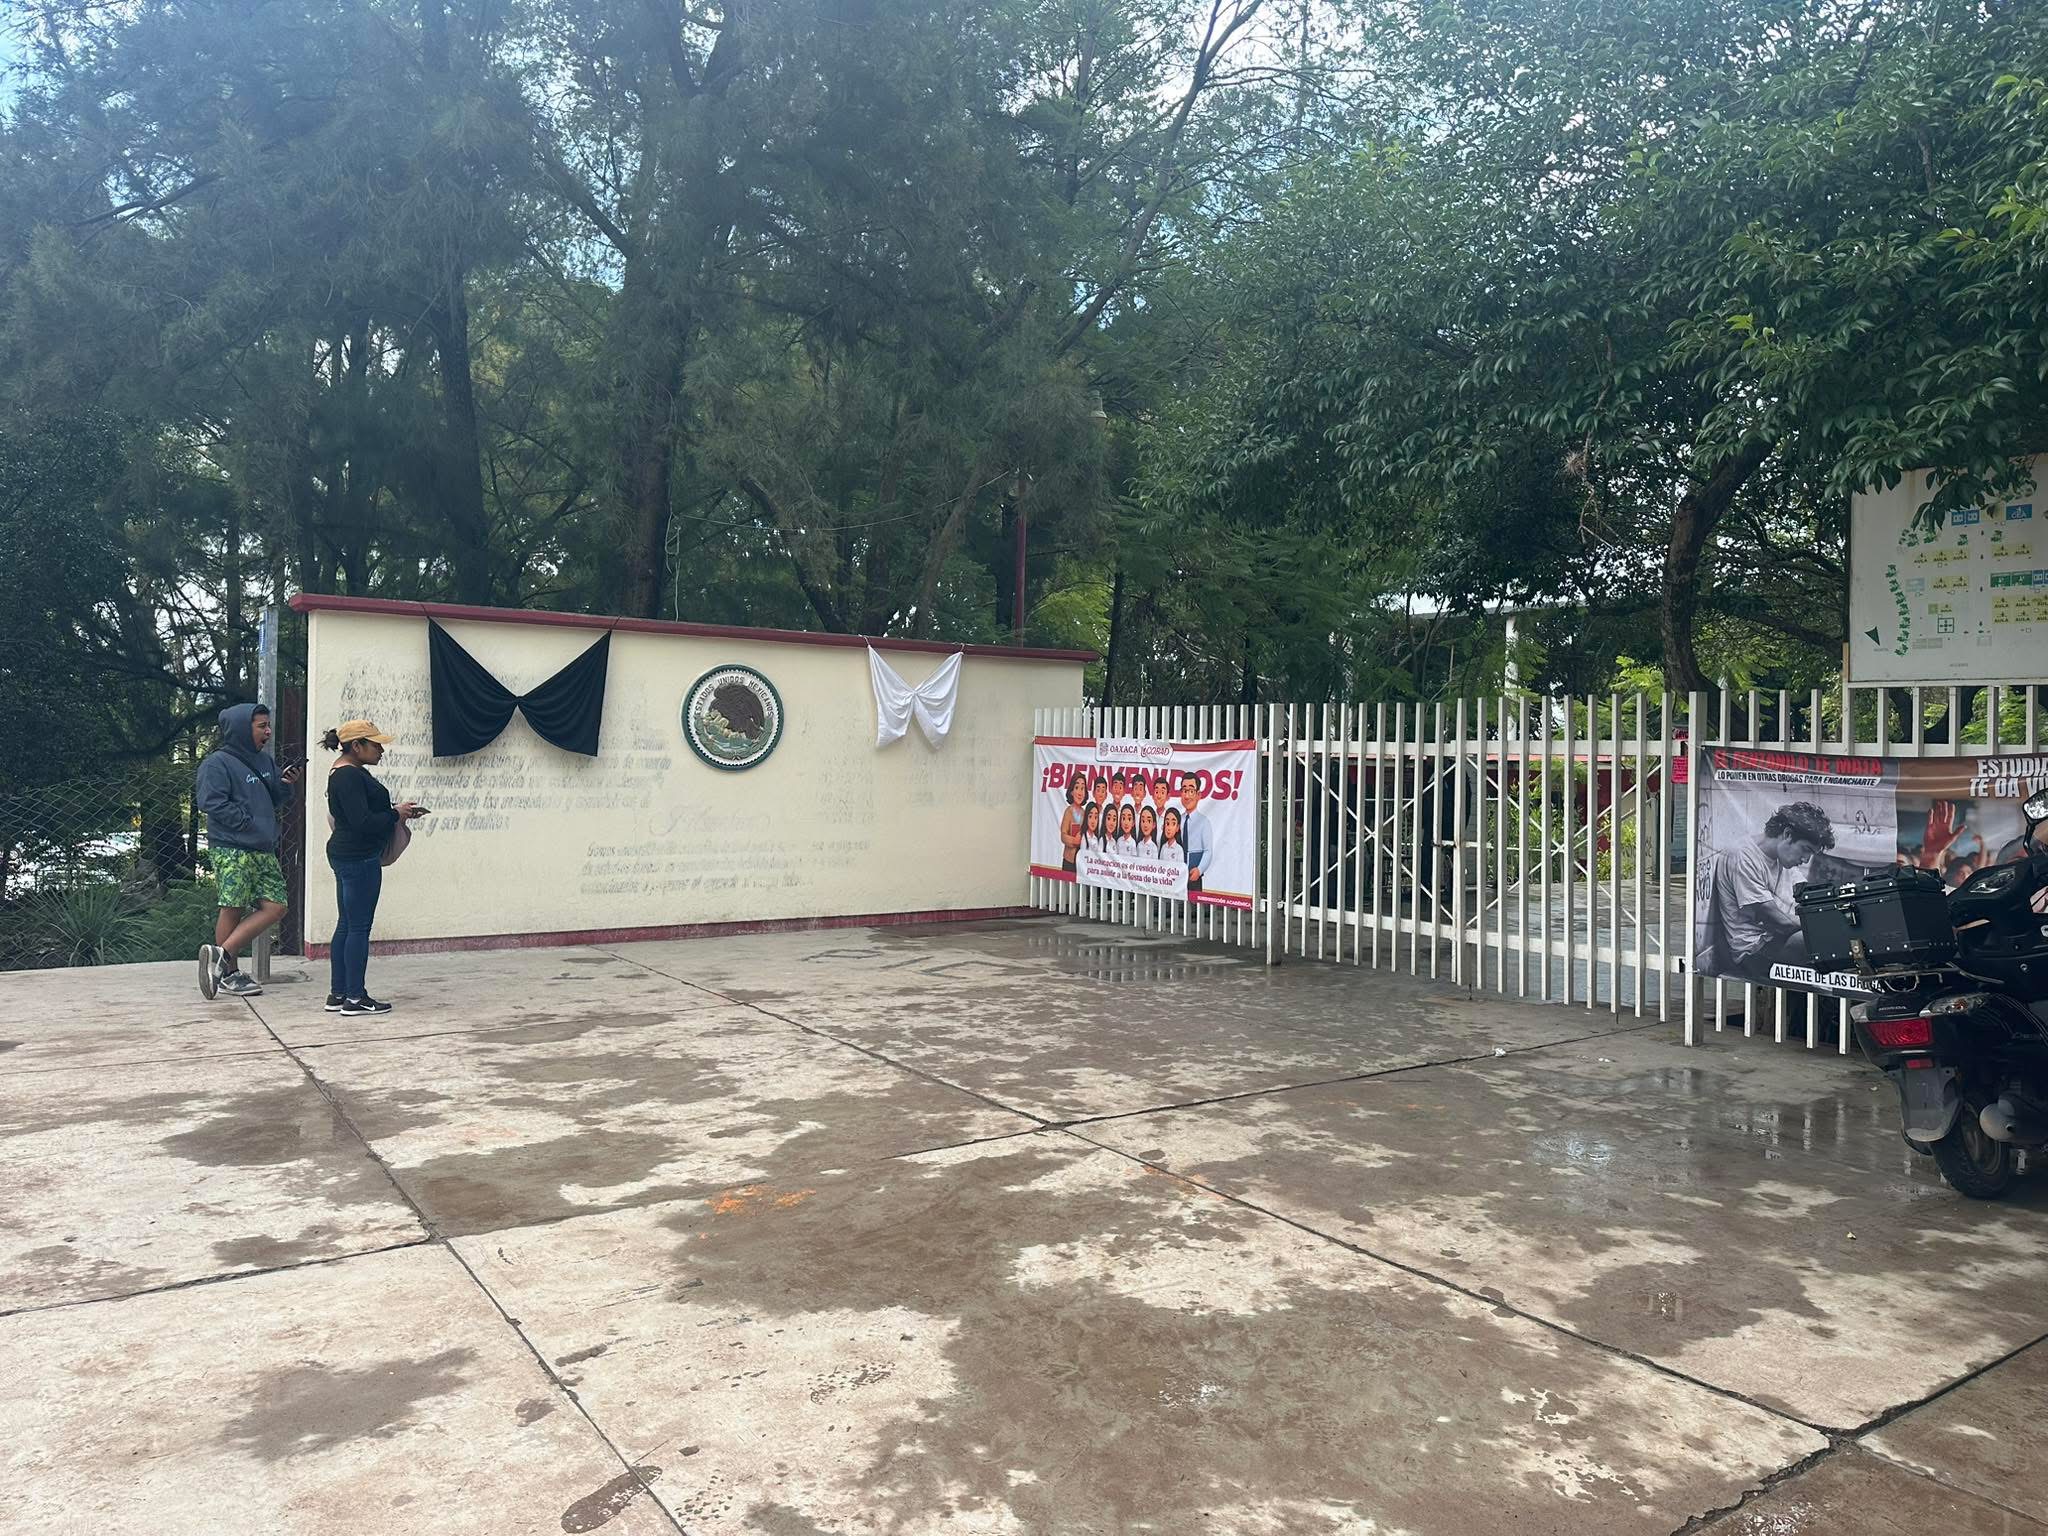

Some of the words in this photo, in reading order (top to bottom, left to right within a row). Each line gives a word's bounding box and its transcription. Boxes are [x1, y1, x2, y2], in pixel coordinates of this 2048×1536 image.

[694, 684, 714, 716] ESTADOS
[717, 675, 745, 685] UNIDOS
[747, 680, 775, 718] MEXICANOS
[1110, 745, 1138, 754] OAXACA
[1714, 750, 1728, 769] EL
[1733, 751, 1809, 772] FENTANILO
[1815, 756, 1830, 773] TE
[1836, 757, 1883, 775] MATA
[1717, 771, 1725, 780] LO
[1748, 773, 1757, 781] EN
[1757, 773, 1777, 782] OTRAS
[1777, 774, 1803, 783] DROGAS
[1804, 776, 1823, 784] PARA
[1823, 776, 1877, 786] ENGANCHARTE
[1970, 778, 1990, 797] TE
[1994, 777, 2020, 798] DA
[1086, 867, 1099, 875] para
[1143, 873, 1152, 883] de
[1152, 875, 1158, 884] la
[1157, 866, 1166, 875] de
[1167, 867, 1180, 877] gala
[1775, 965, 1812, 982] ALÉJATE
[1815, 972, 1827, 984] DE
[1829, 973, 1847, 987] LAS
